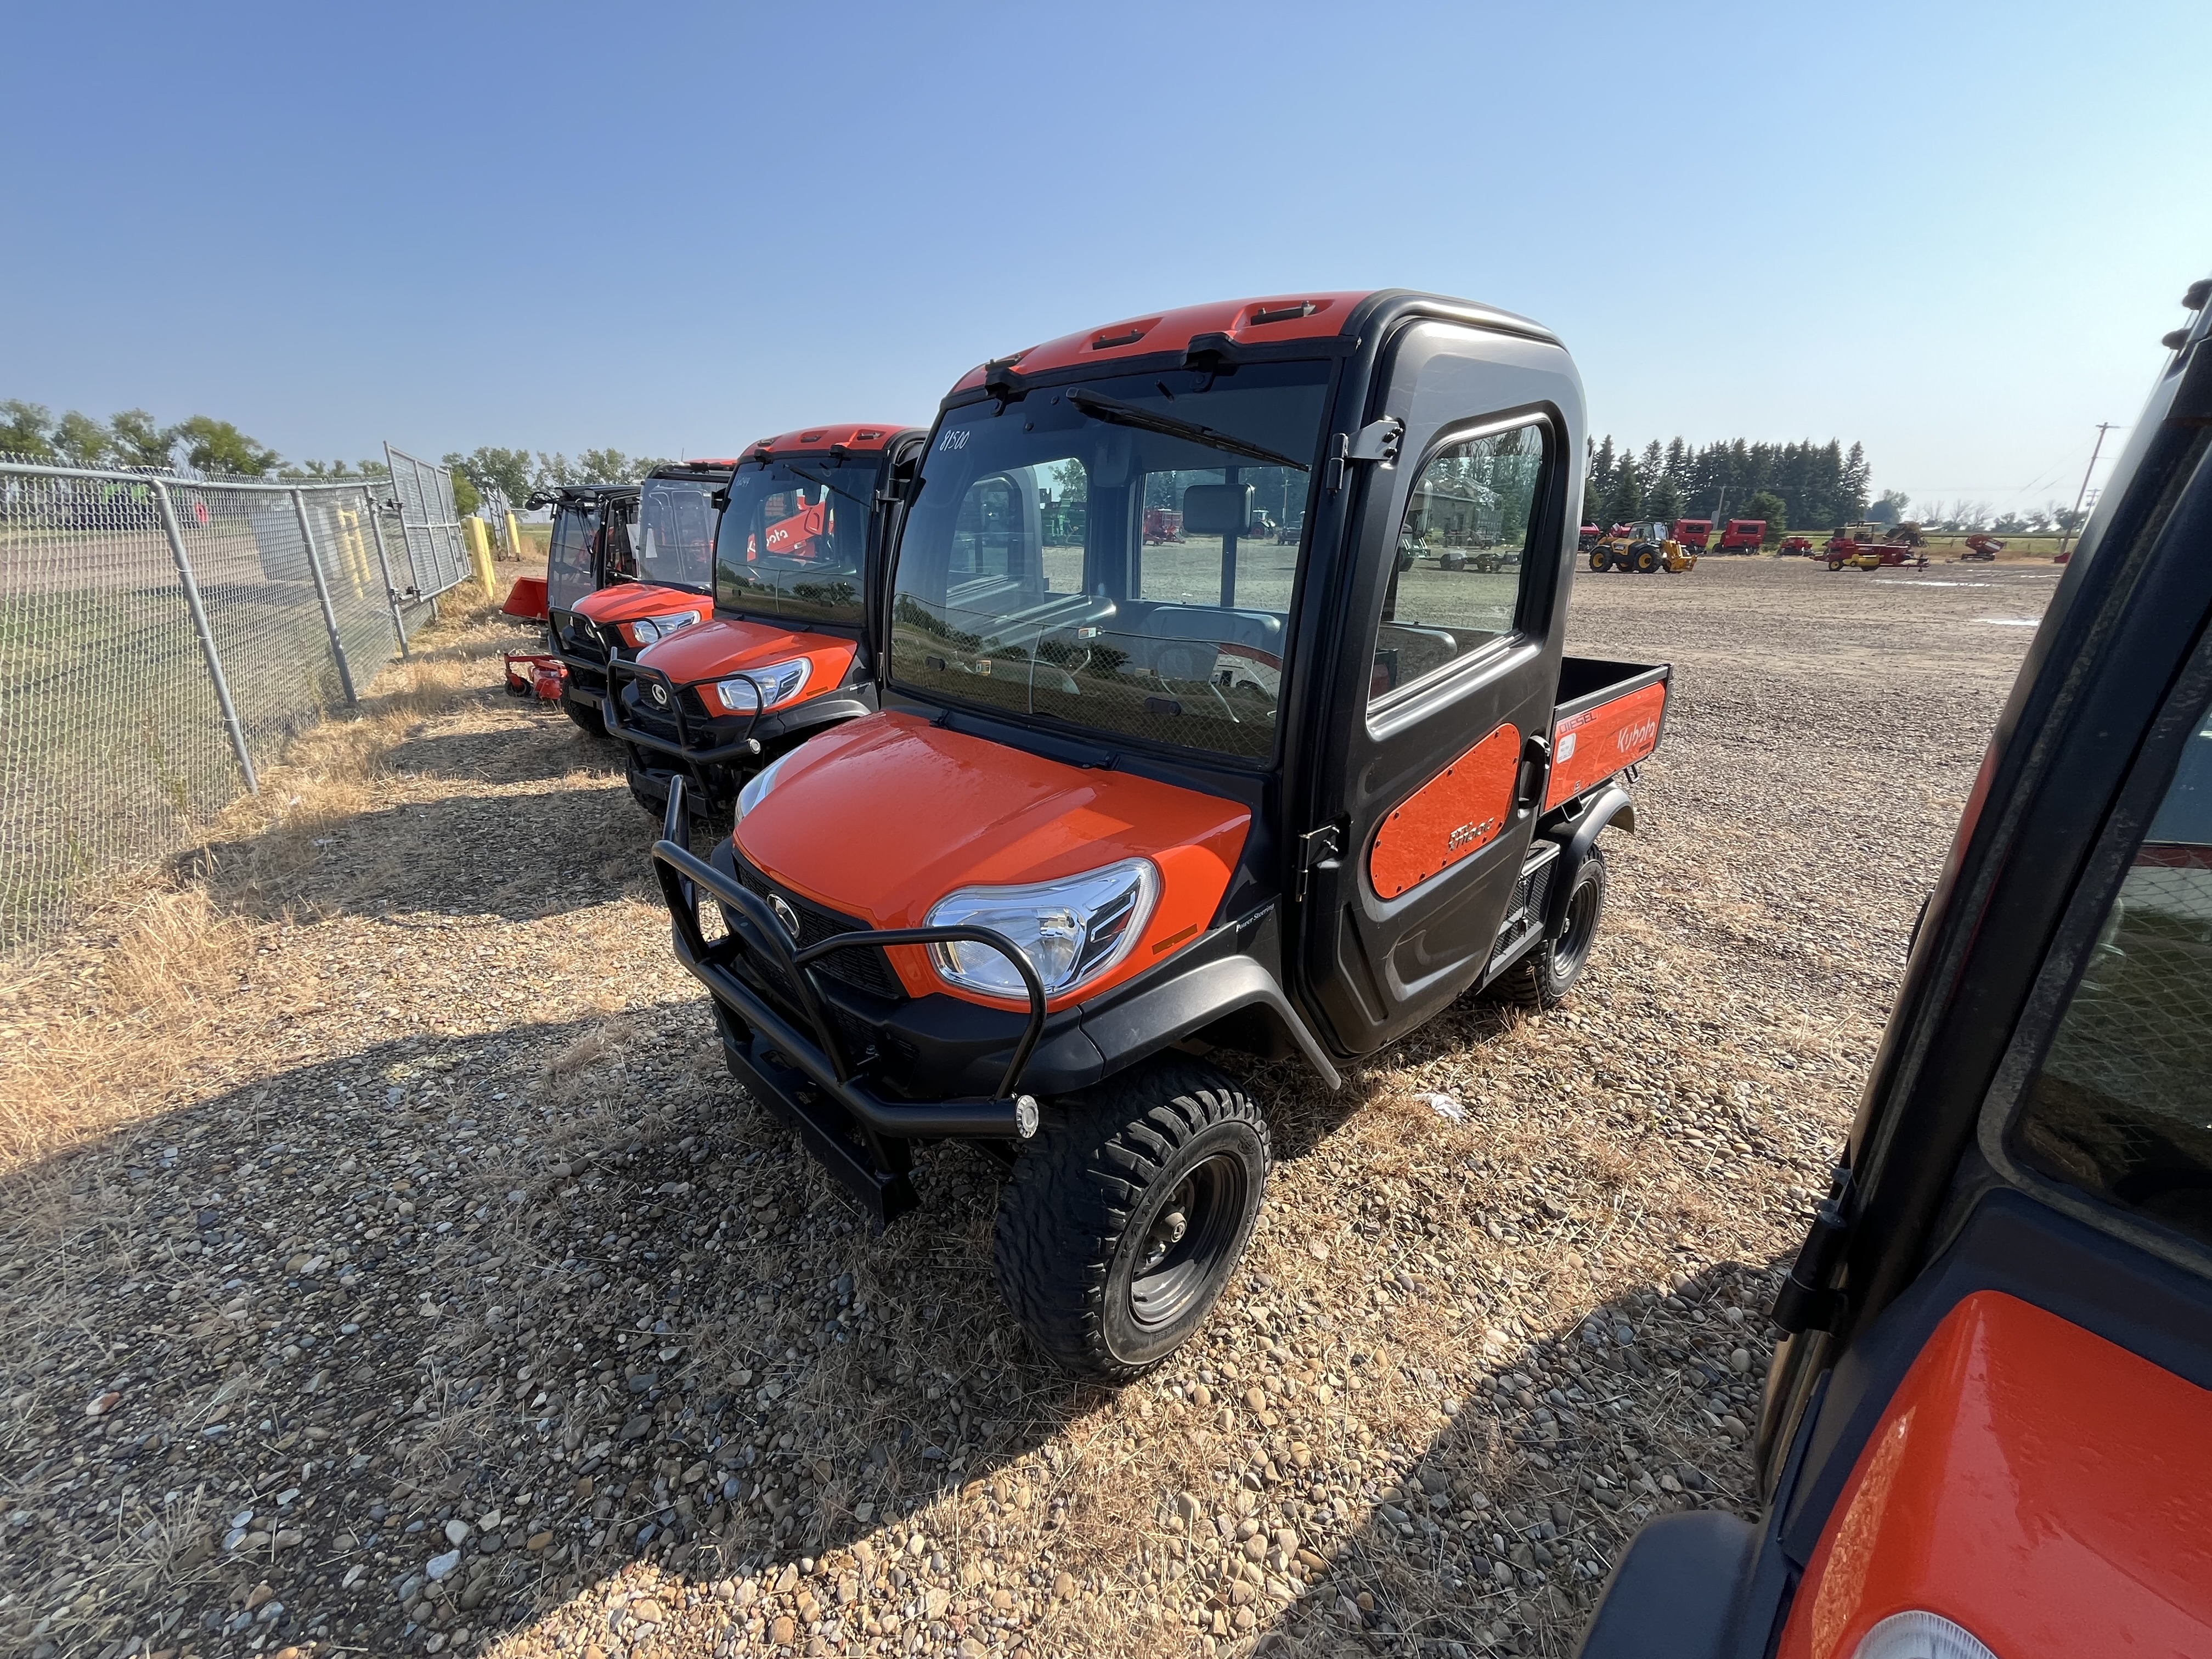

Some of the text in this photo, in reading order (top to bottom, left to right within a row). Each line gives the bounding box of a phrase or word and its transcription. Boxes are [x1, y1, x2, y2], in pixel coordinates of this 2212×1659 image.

[1559, 712, 1597, 734] DIESEL
[1617, 716, 1655, 753] Kubota
[1235, 903, 1274, 934] Power Steering
